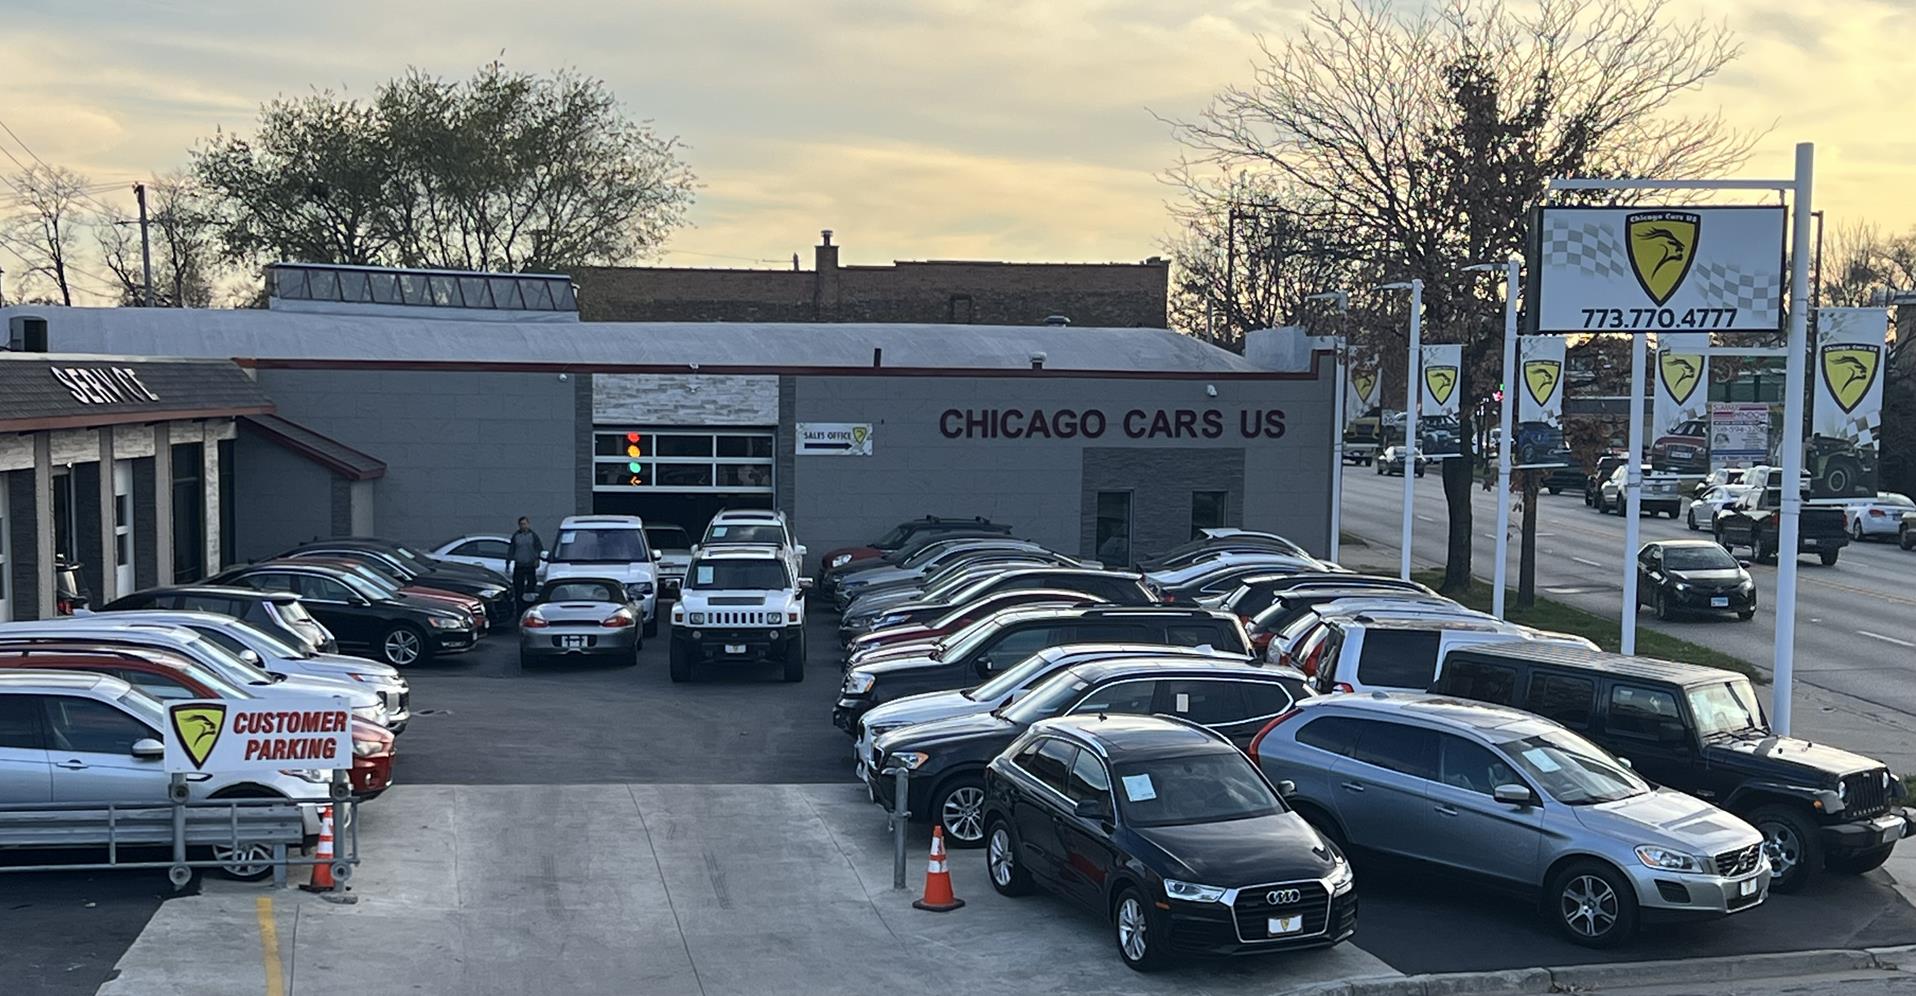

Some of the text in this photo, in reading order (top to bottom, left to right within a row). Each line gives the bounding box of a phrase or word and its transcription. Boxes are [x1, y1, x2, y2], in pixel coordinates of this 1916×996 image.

[1630, 214, 1663, 223] Chicago
[1686, 215, 1697, 223] US
[1581, 308, 1738, 329] 773.770.4777
[51, 366, 160, 404] SERVICE
[804, 431, 851, 440] SALES OFFICE
[939, 409, 1287, 440] CHICAGO CARS US
[233, 711, 348, 734] CUSTOMER
[245, 738, 337, 761] PARKING
